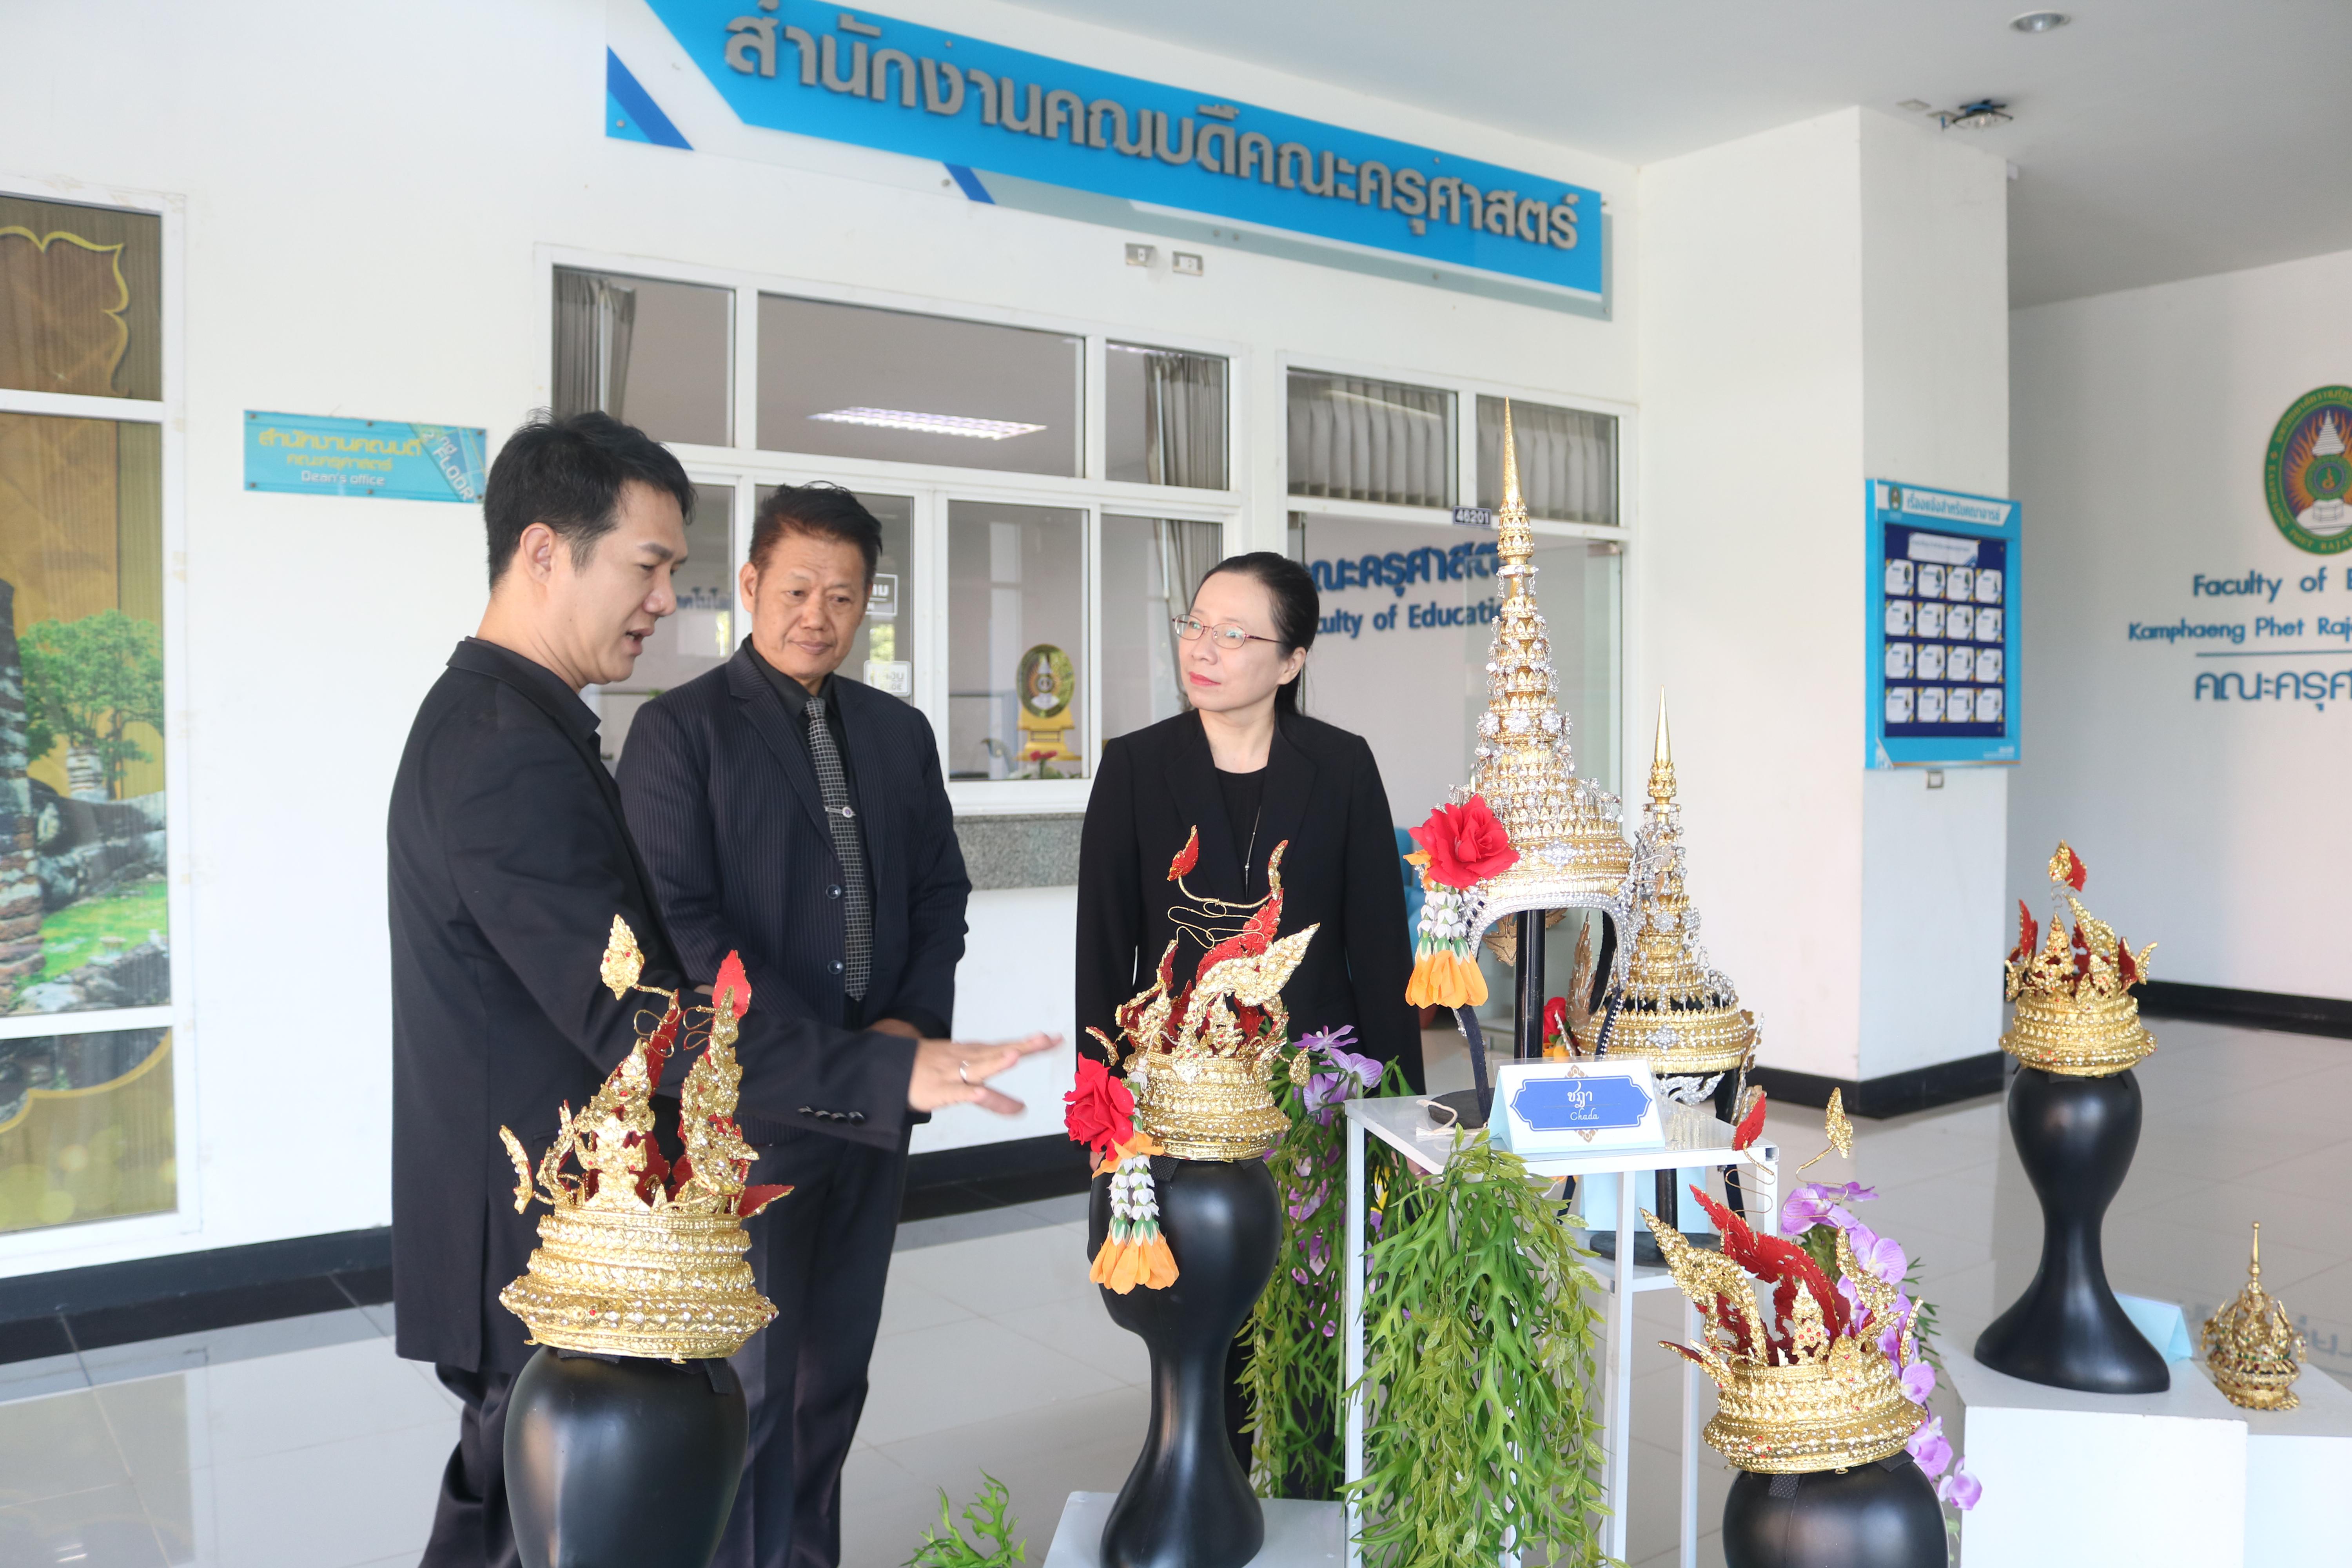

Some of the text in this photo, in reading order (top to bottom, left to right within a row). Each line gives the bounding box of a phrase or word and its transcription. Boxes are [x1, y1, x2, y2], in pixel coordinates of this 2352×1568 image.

[350, 474, 386, 487] office
[1456, 508, 1489, 524] 46201
[2193, 569, 2283, 603] Faculty
[2299, 565, 2328, 593] of
[1373, 603, 1398, 631] of
[1408, 597, 1503, 628] Educati
[2128, 617, 2246, 644] Kamphaeng
[2255, 616, 2305, 637] Phet
[2194, 670, 2352, 712] คณะครุศ
[1567, 1080, 1593, 1109] ชฎา
[1570, 1107, 1600, 1121] Chada
